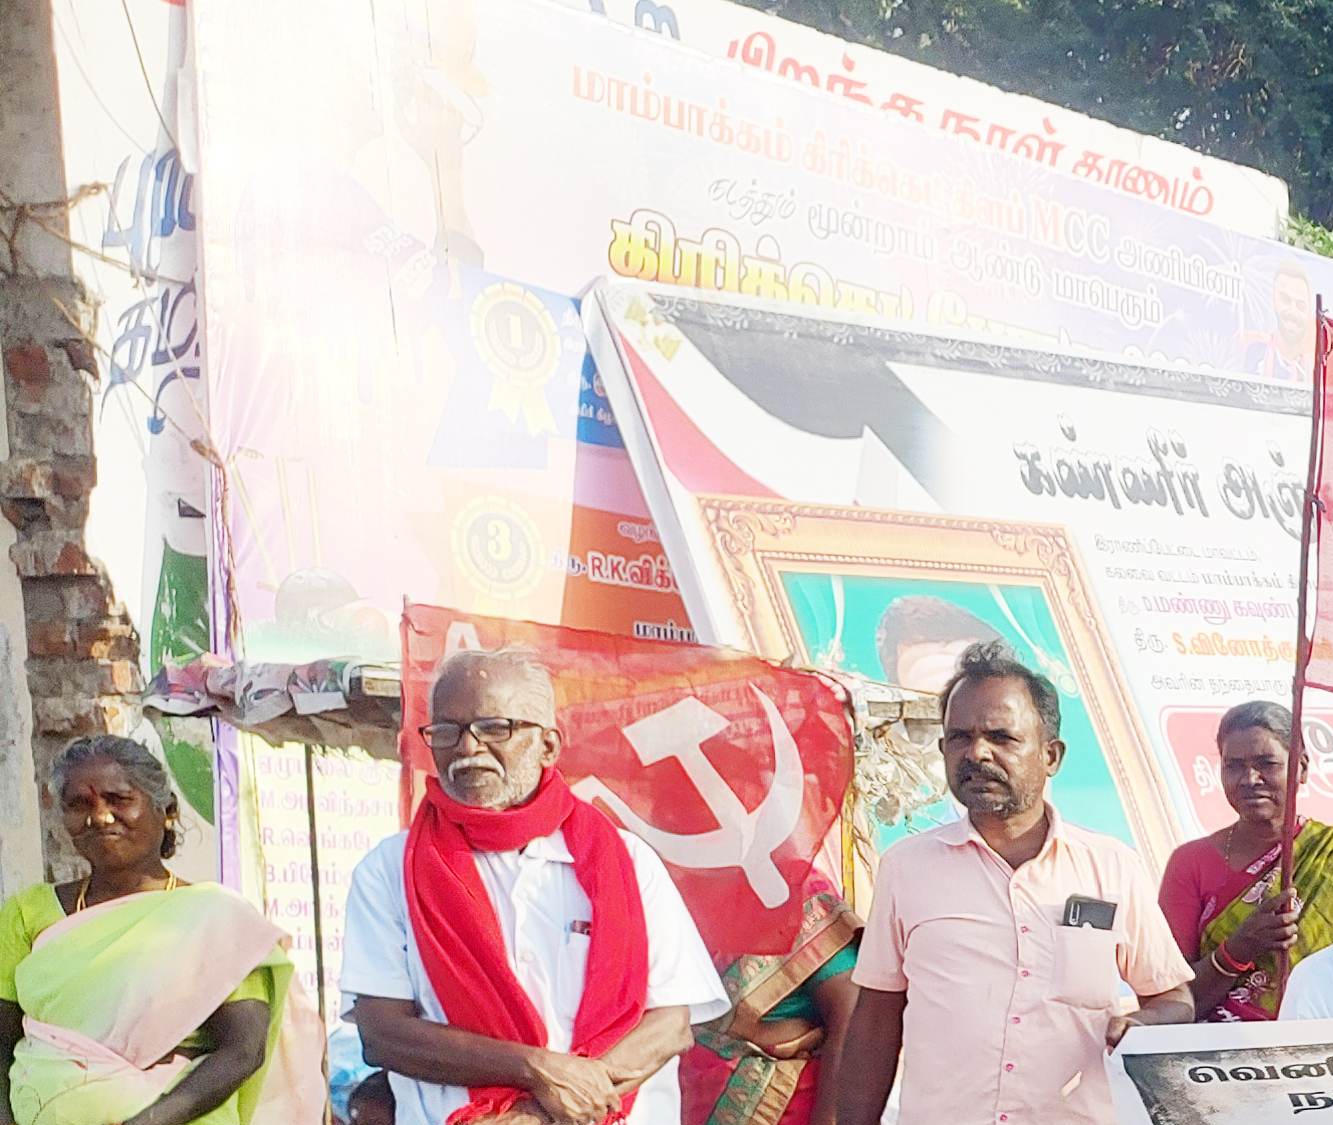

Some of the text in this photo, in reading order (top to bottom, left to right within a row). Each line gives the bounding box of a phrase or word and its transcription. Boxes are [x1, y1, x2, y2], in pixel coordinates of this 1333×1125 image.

[572, 65, 1244, 300] மாம்பாக்கம் கிரிக்கெட் கிளப் MCC அணியினர்
[708, 178, 797, 226] நடத்தும்
[808, 201, 936, 260] மூன்றாம்
[951, 237, 1042, 298] ஆண்டு
[1054, 270, 1165, 327] மாபெரும்
[1013, 413, 1210, 518] கண்ணீர்
